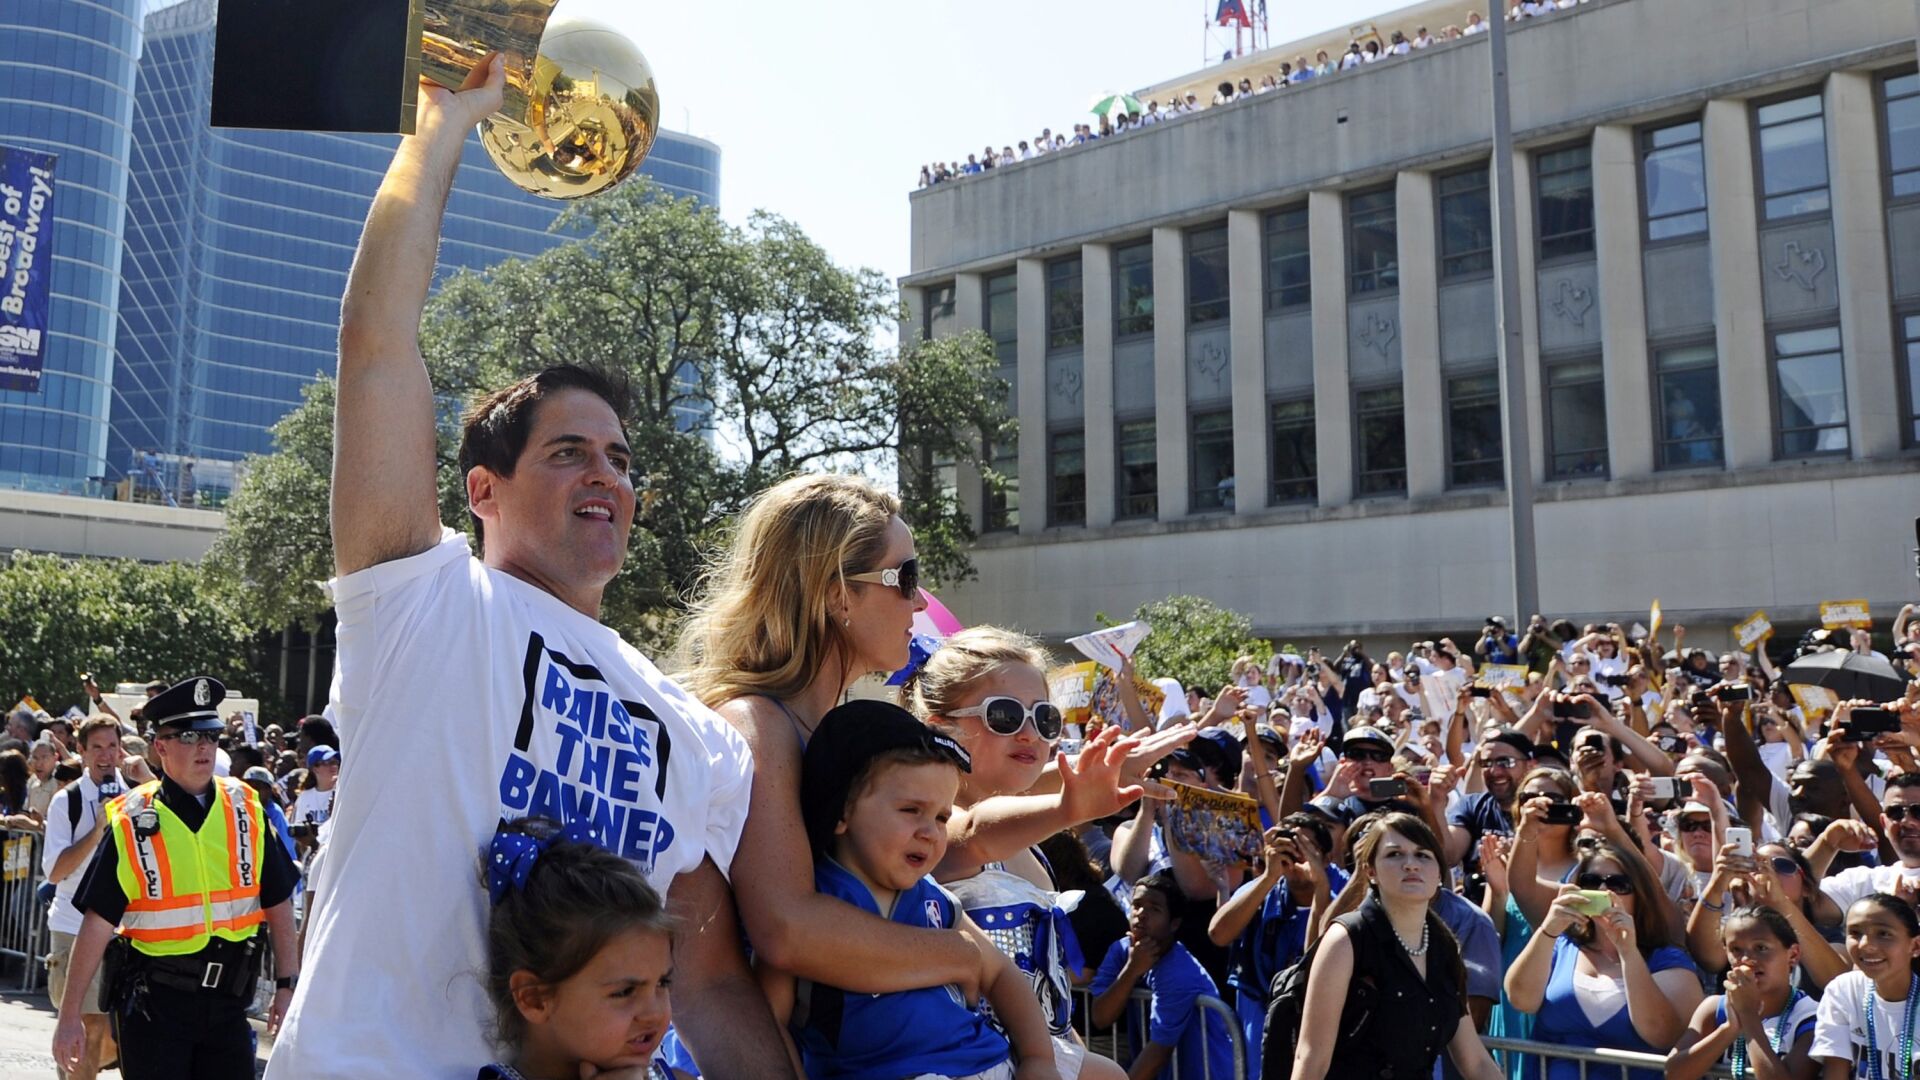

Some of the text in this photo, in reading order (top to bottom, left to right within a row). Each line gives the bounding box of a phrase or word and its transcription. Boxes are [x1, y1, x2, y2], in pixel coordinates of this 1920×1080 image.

[0, 182, 22, 216] of
[1, 166, 52, 316] Broadway!
[541, 663, 651, 768] RAISE
[555, 722, 645, 802] THE
